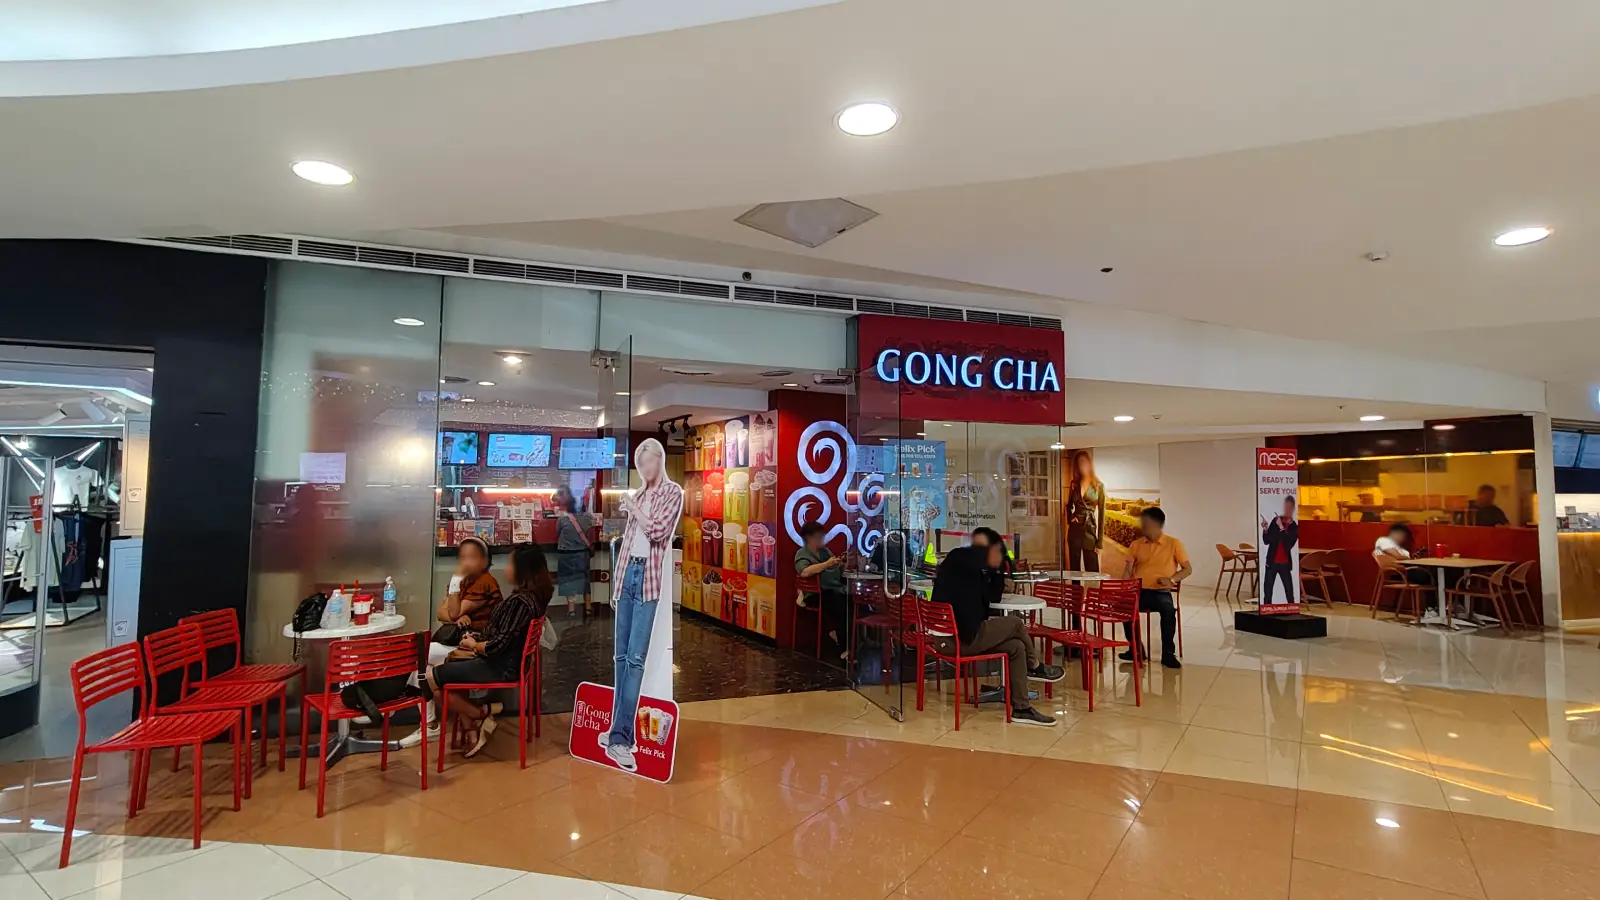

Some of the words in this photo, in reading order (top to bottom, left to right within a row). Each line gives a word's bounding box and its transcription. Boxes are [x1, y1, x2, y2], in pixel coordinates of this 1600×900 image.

[877, 349, 983, 388] GONG
[993, 358, 1060, 392] CHA
[917, 445, 936, 454] Pick
[1259, 452, 1296, 466] mesa
[1262, 476, 1285, 484] READY
[586, 704, 611, 724] Gong
[585, 716, 600, 730] cha
[639, 745, 653, 756] Felix
[653, 749, 666, 760] Pick
